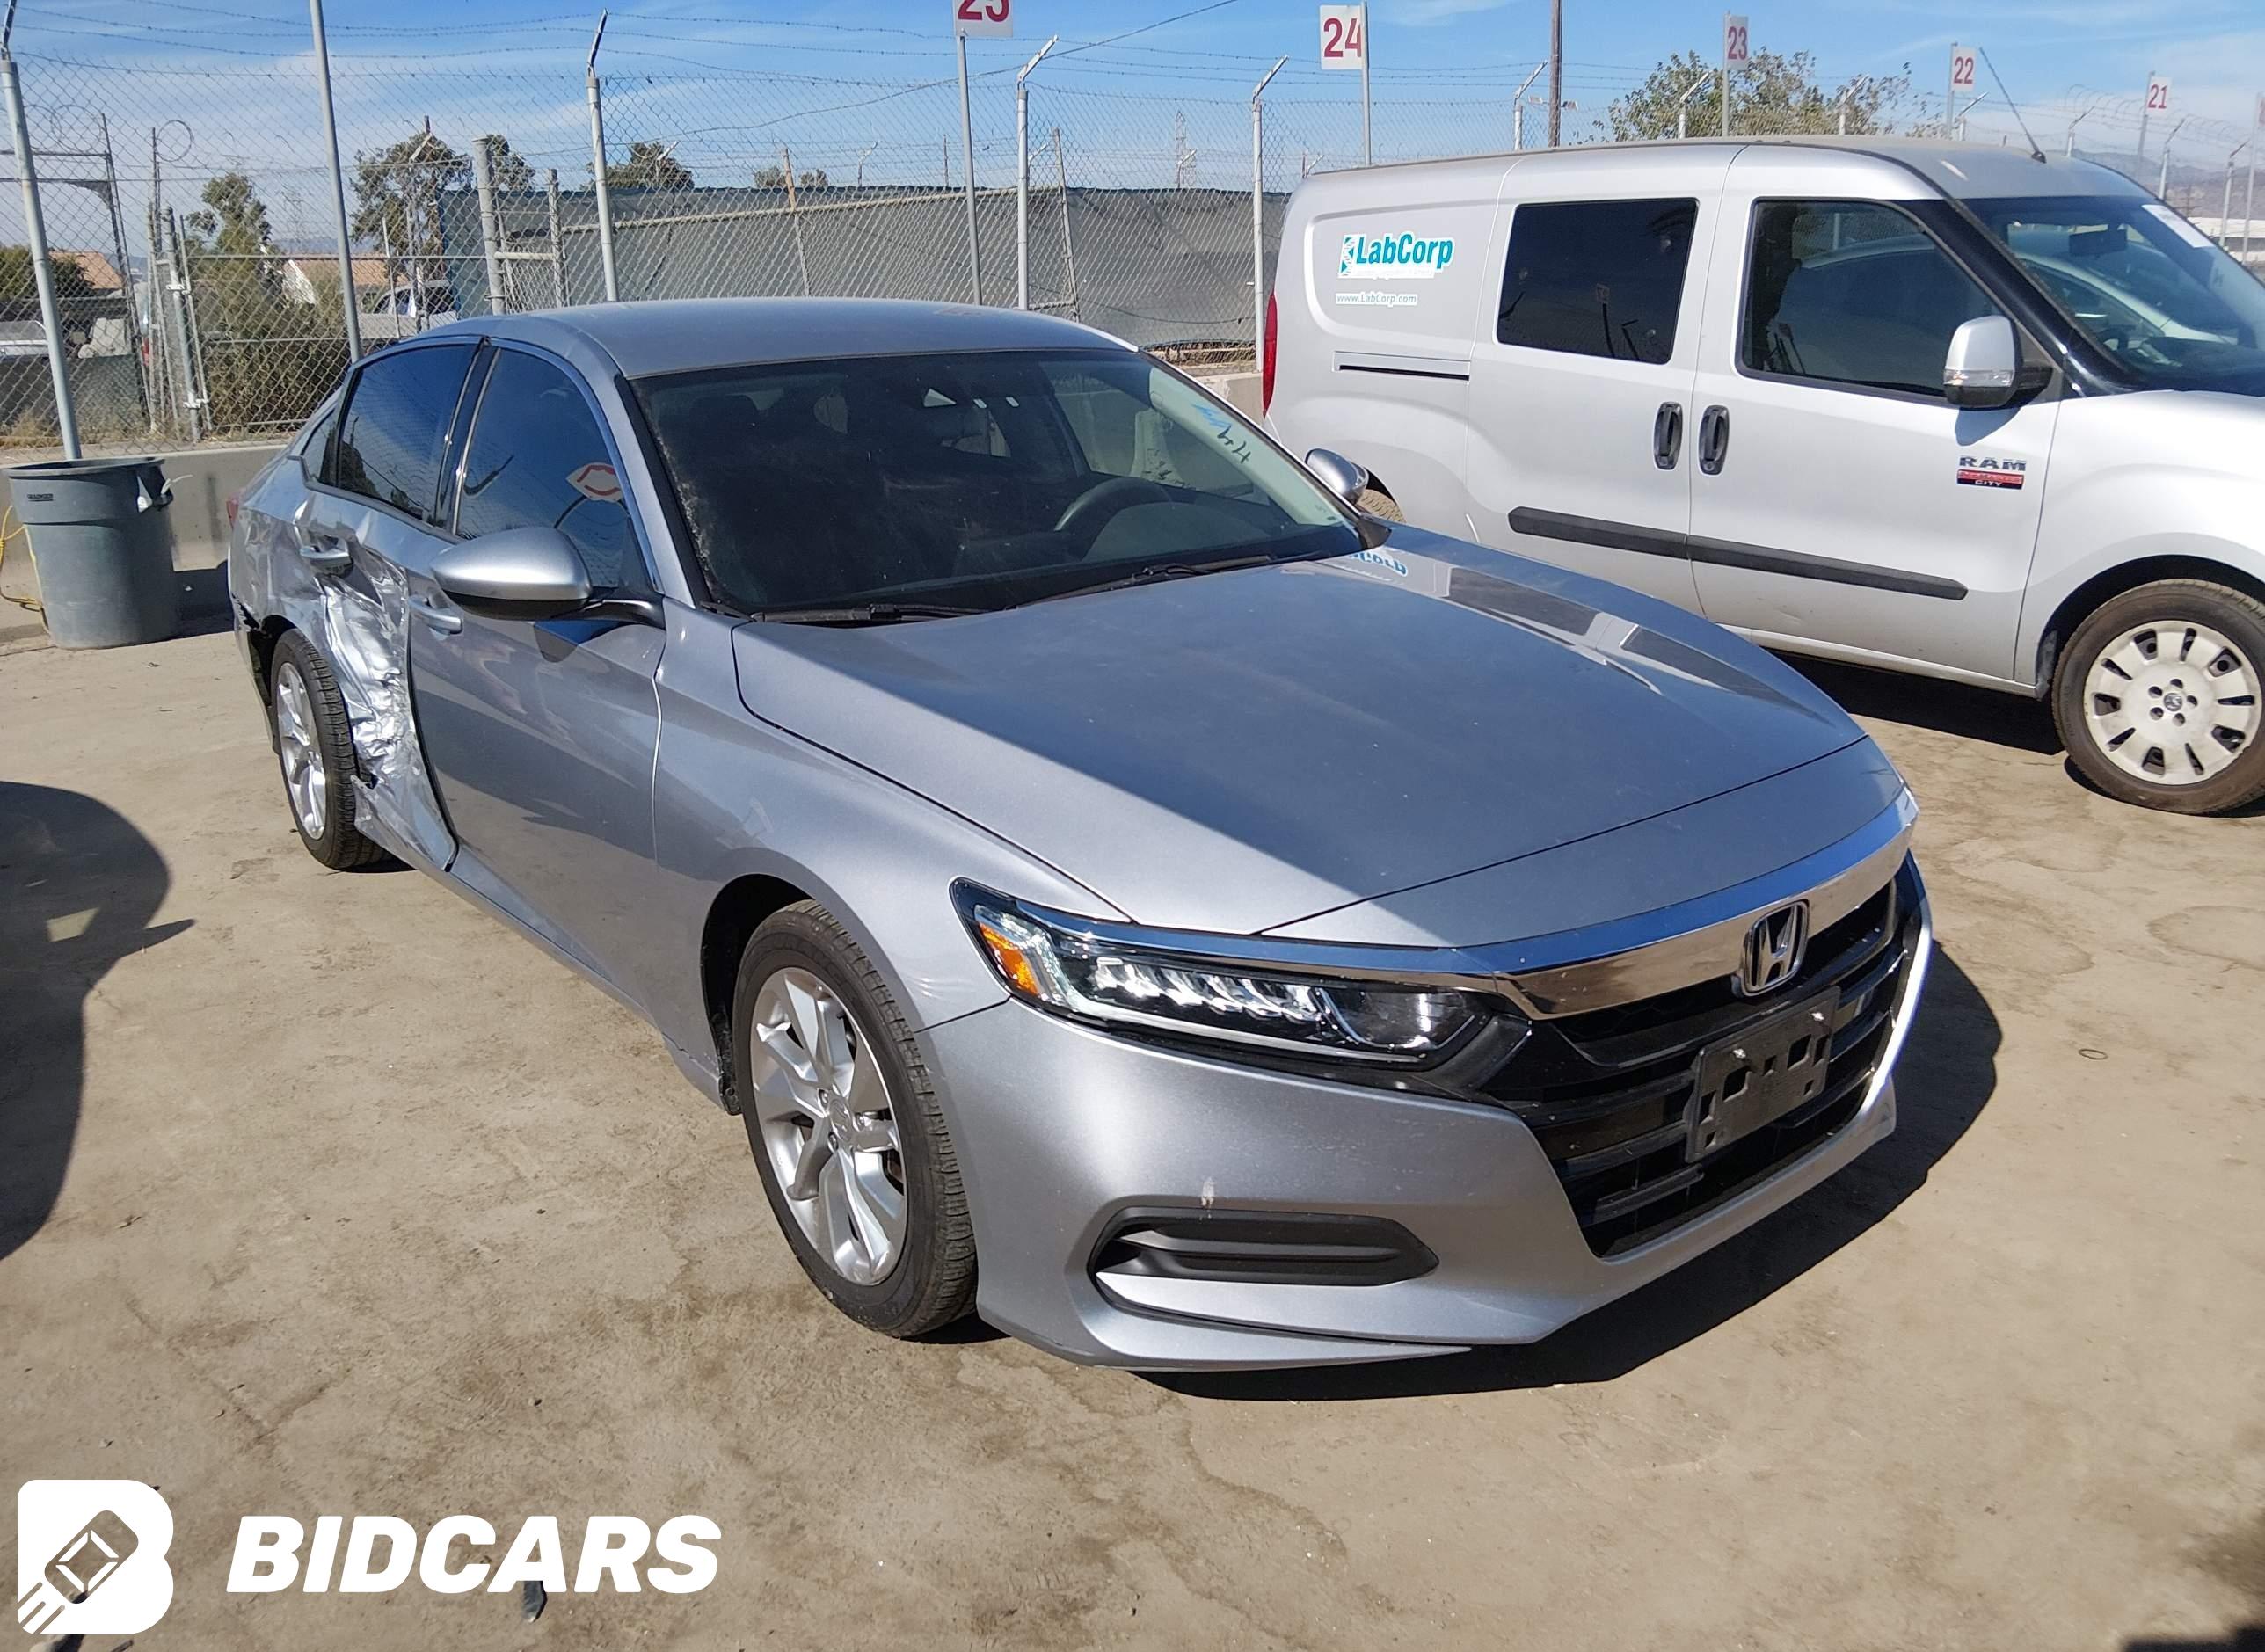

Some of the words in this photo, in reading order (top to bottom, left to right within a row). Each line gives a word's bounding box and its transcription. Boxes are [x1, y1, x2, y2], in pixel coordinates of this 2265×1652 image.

[1323, 18, 1362, 58] 24
[1728, 26, 1747, 60] 23
[1954, 55, 1974, 84] 22
[2148, 84, 2167, 109] 21
[1356, 233, 1453, 270] LabCorp
[1336, 293, 1417, 304] www.LabCorp.com
[1958, 455, 2027, 472] RAM
